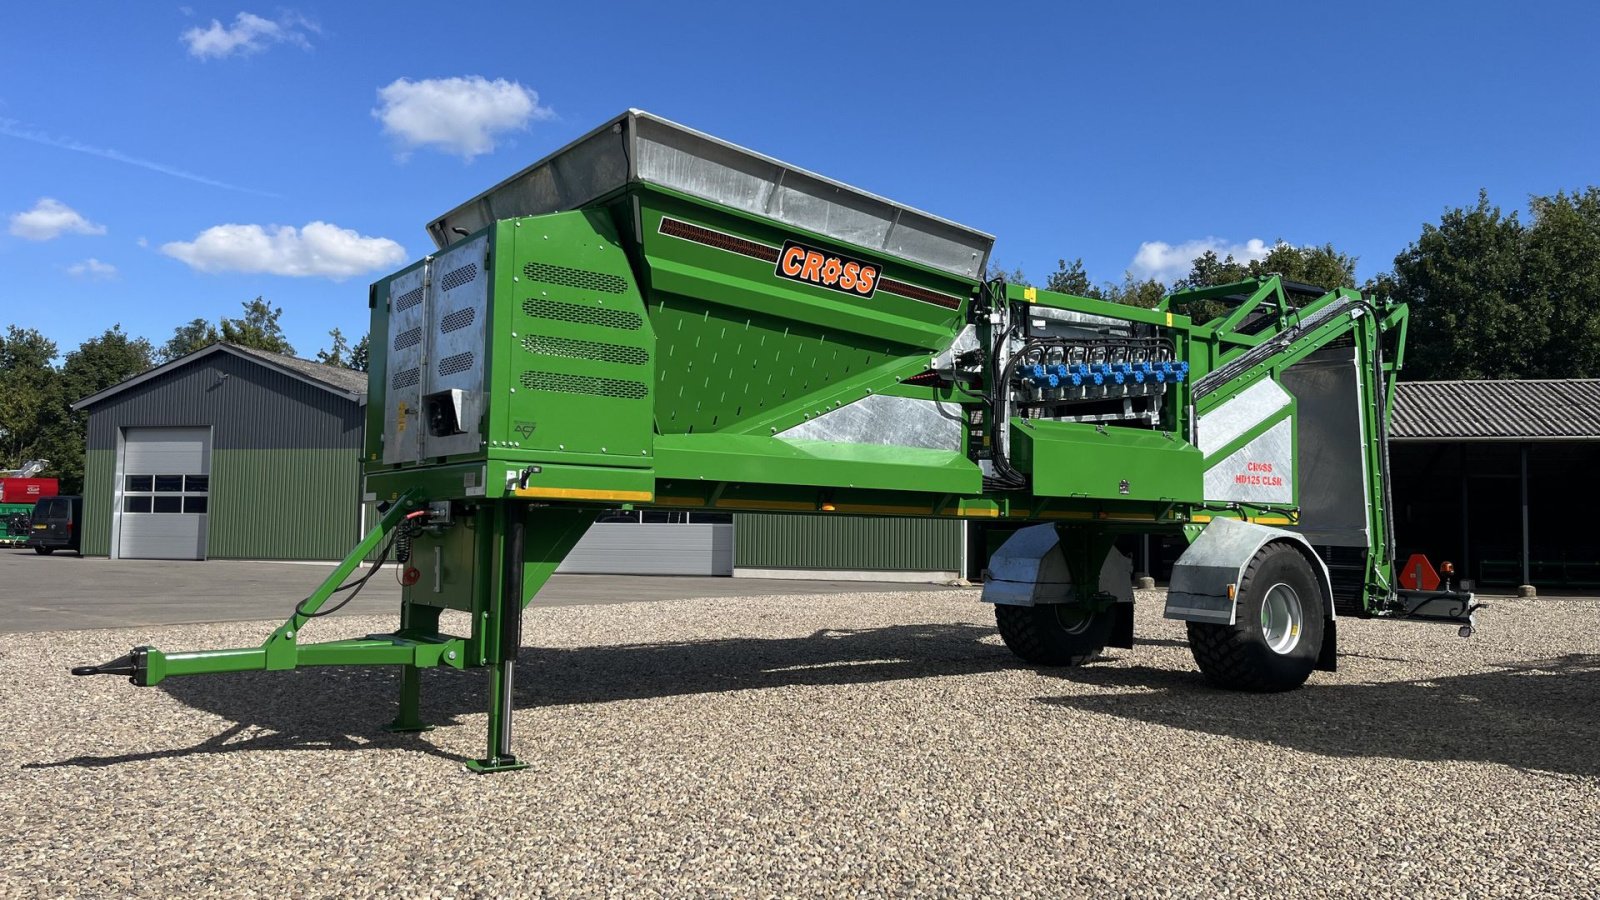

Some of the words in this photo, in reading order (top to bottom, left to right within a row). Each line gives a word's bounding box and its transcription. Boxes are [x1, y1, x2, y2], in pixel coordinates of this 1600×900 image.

[782, 246, 876, 294] CROSS
[1247, 462, 1273, 472] CROSS
[1235, 474, 1260, 484] HD125
